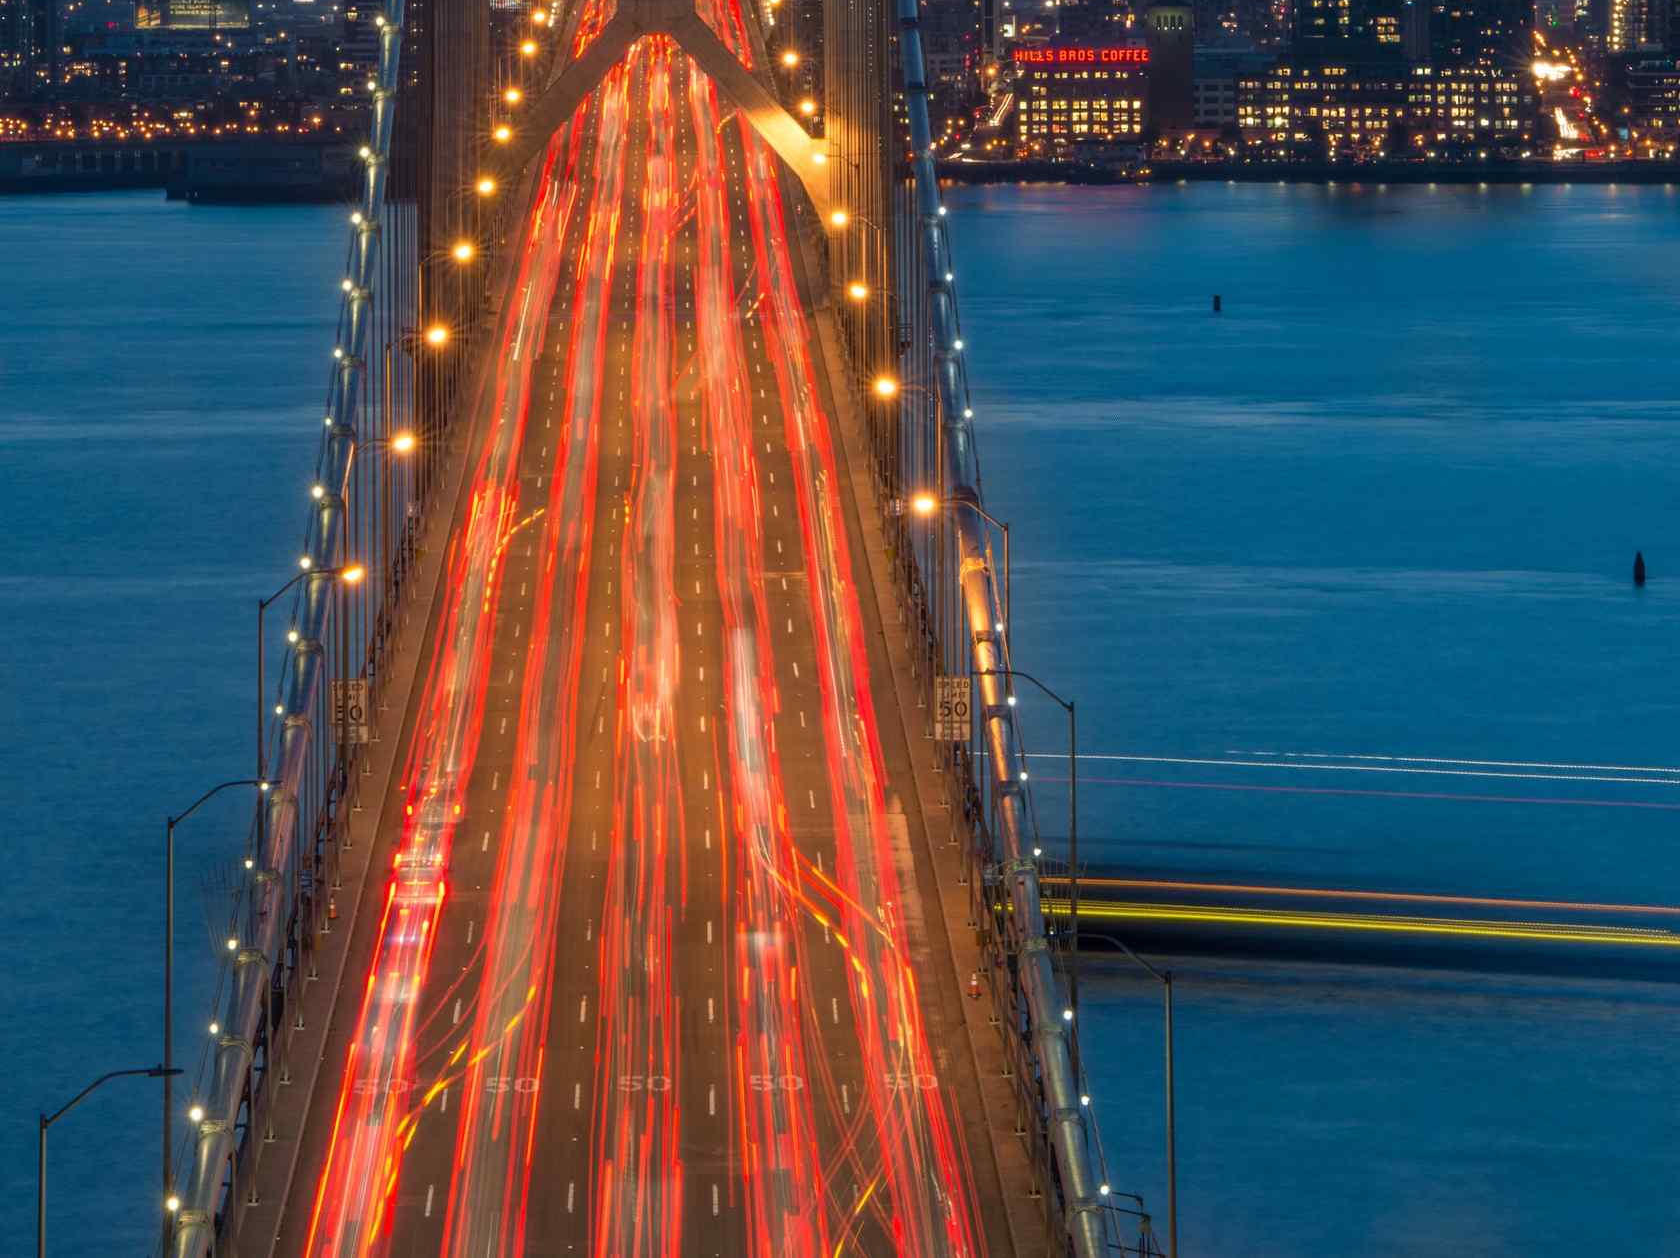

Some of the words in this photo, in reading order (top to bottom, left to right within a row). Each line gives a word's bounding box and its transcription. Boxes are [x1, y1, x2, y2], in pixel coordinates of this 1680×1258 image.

[1014, 49, 1054, 62] HILLS
[1059, 49, 1095, 61] BROS
[1101, 49, 1149, 61] COFFEE
[939, 701, 968, 717] 50
[353, 1077, 408, 1094] 50
[486, 1077, 539, 1093] 50
[617, 1076, 671, 1092] 50
[750, 1075, 803, 1091] 50
[884, 1074, 937, 1090] 50
